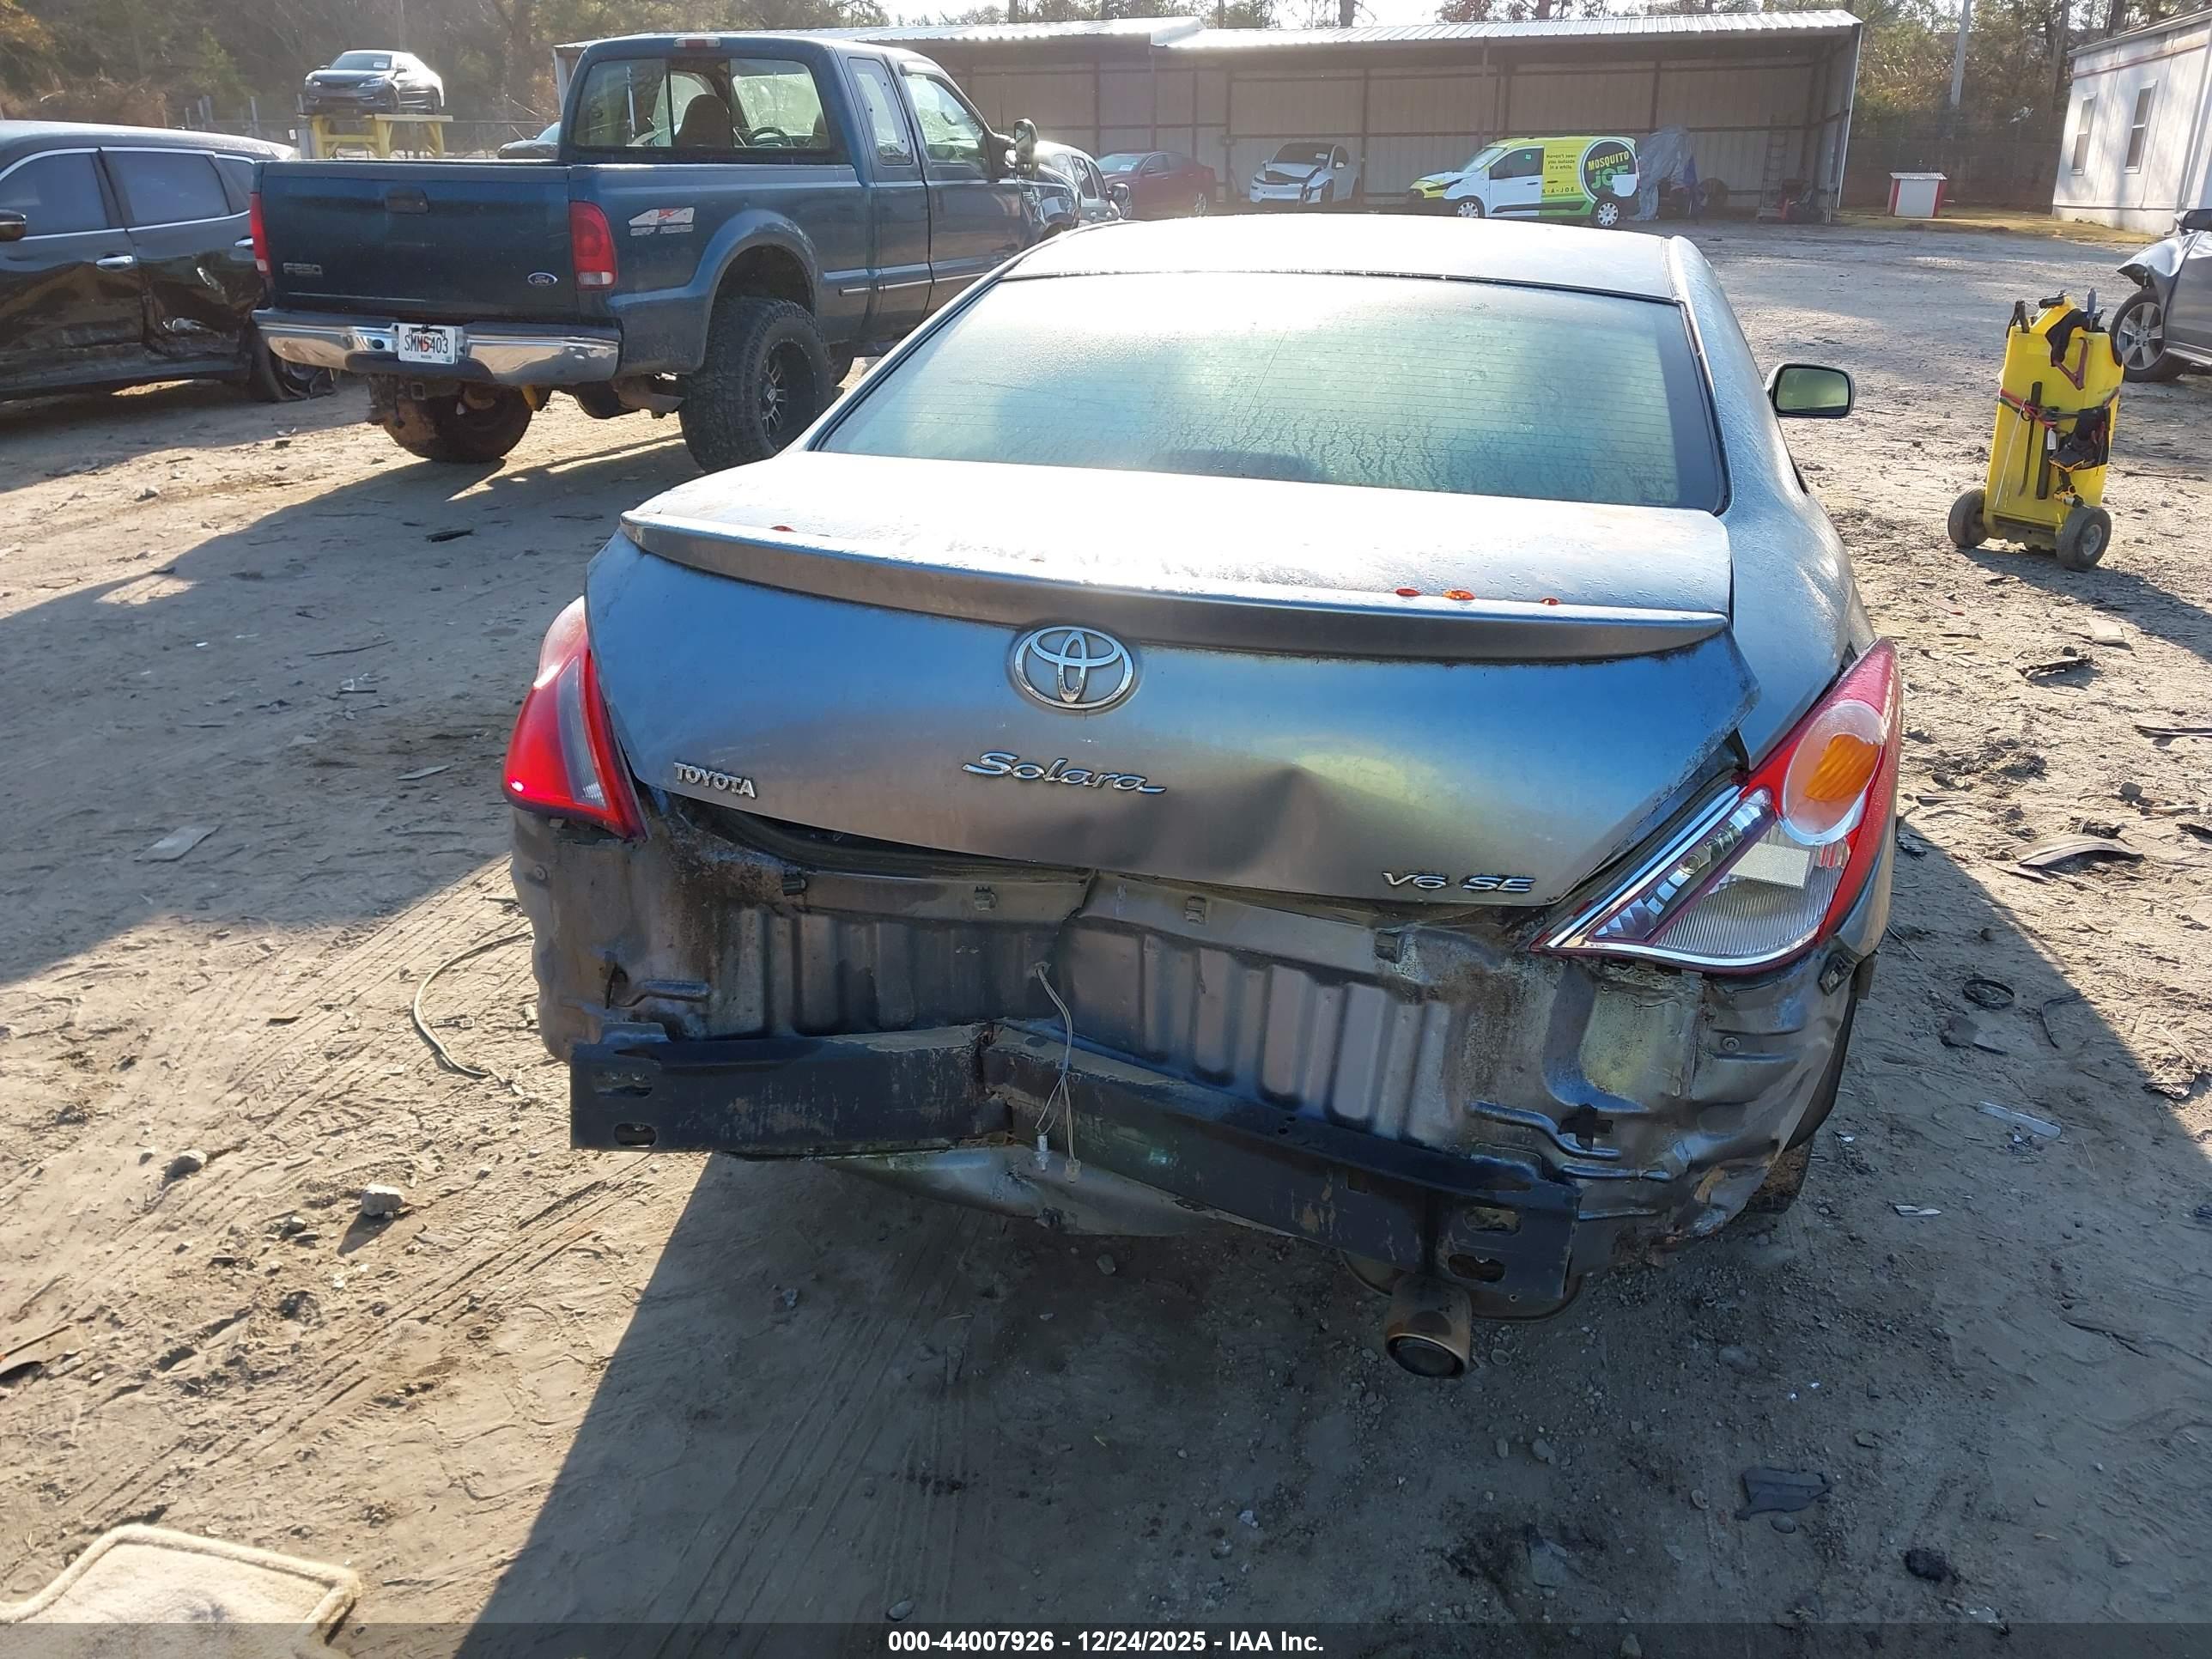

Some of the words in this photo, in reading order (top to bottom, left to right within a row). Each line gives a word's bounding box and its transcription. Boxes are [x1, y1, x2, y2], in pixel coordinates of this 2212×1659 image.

[1588, 151, 1629, 171] MOSQUITO
[673, 762, 757, 799] TOYOTA
[962, 750, 1167, 794] Solara
[1382, 871, 1448, 890] V6
[1461, 874, 1536, 893] SE
